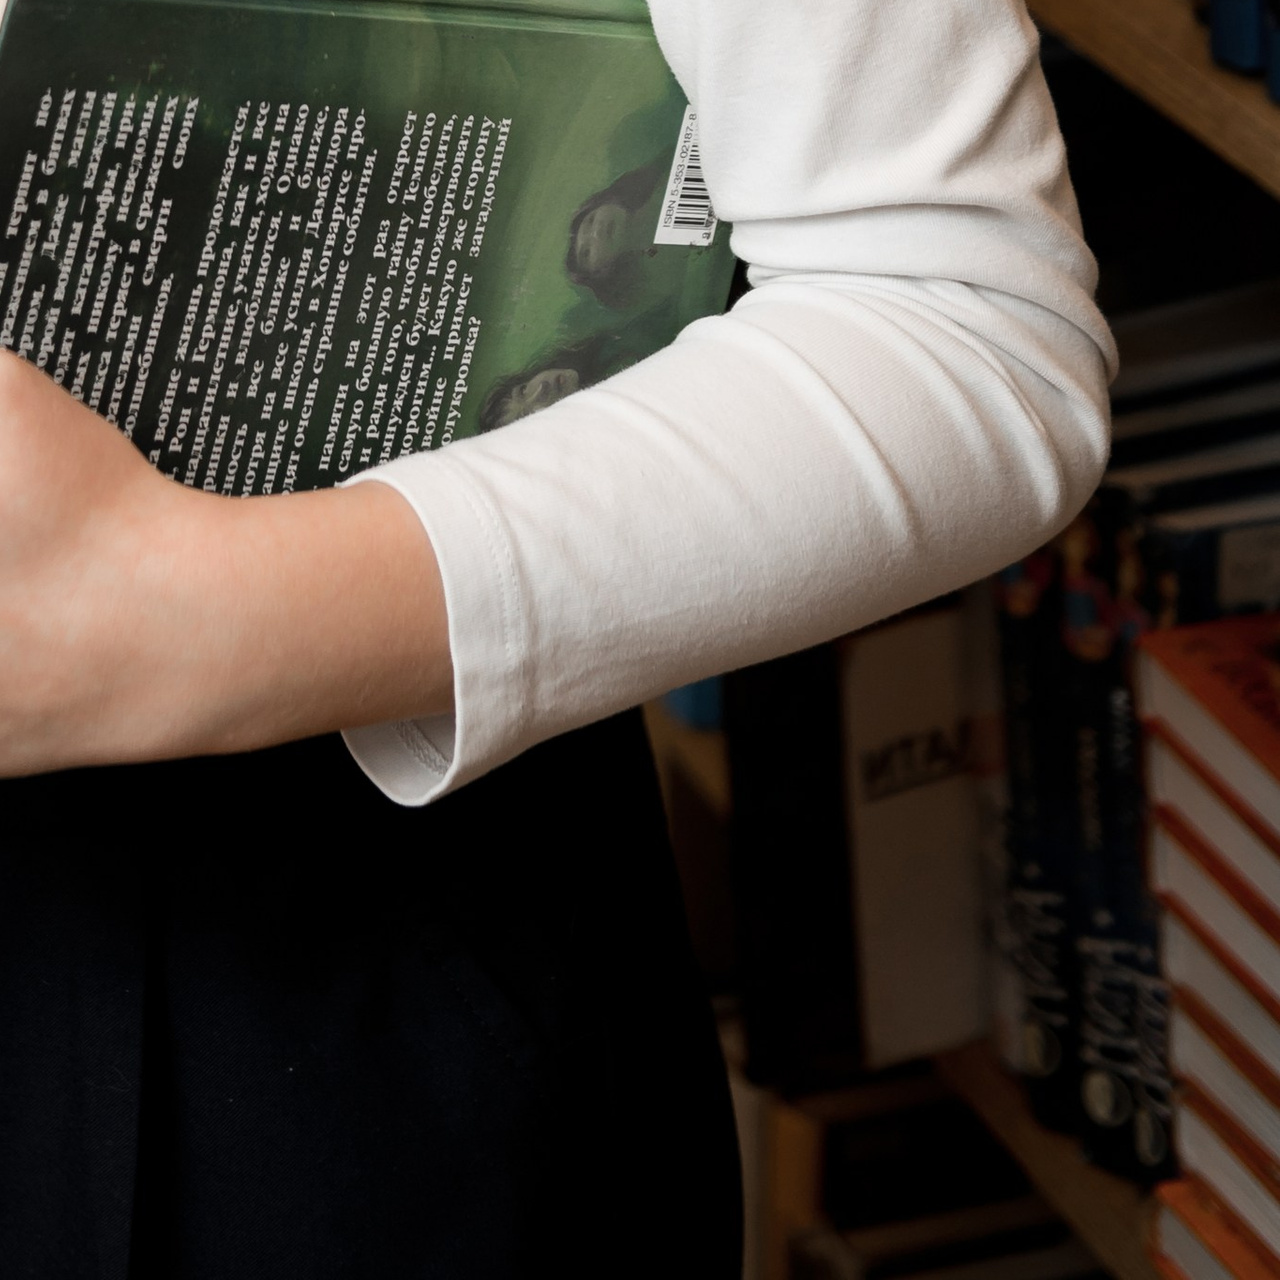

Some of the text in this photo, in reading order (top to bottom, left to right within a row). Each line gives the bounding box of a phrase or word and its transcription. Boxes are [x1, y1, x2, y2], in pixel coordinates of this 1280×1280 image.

[5, 150, 38, 239] терпит
[35, 87, 53, 127] по-
[31, 307, 61, 369] орой
[53, 221, 84, 301] войны
[82, 91, 118, 189] каждый
[36, 189, 49, 205] в
[40, 193, 69, 261] Даже
[67, 90, 97, 168] маглы
[41, 89, 77, 176] битвах
[48, 92, 137, 385] одят катастрофы, при-
[65, 94, 159, 400] рых никому неведомы.
[105, 262, 135, 343] теряет
[128, 238, 141, 254] в
[135, 95, 180, 231] сражениях
[229, 184, 250, 227] как
[244, 154, 257, 171] и
[251, 101, 271, 140] все
[405, 282, 432, 346] будет
[425, 114, 475, 276] пожертвовать
[427, 259, 458, 336] Какую
[451, 218, 468, 251] же
[462, 115, 496, 211] сторону
[662, 113, 698, 228] ISBN 5-353-02187-8
[100, 96, 200, 427] рателями смерти своих
[154, 368, 182, 441] войне
[174, 283, 204, 362] жизнь
[196, 100, 251, 277] продолжается.
[179, 103, 291, 487] надцатилетние, учатся, ходят на
[186, 377, 200, 394] и
[191, 240, 237, 363] Гермиона,
[197, 103, 310, 492] ринки и влюбляются. Однако
[216, 105, 330, 497] сность все ближе и ближе.
[235, 107, 349, 500] мотря на все усилия Дамблдора
[262, 108, 366, 495] ащите школы, в Хогвартсе про-
[294, 377, 319, 448] очень
[312, 259, 350, 375] странные
[343, 149, 378, 256] события.
[318, 383, 350, 470] памяти
[344, 339, 361, 368] на
[356, 273, 377, 324] этот
[372, 219, 391, 259] раз
[386, 110, 418, 204] откроет
[338, 399, 364, 473] самую
[355, 286, 393, 392] большую
[386, 212, 414, 279] тайну
[401, 112, 437, 205] Темного
[359, 114, 459, 463] и ради того, чтобы победить,
[421, 117, 513, 448] войне примет загадочный
[441, 316, 482, 447] олукровка?
[168, 408, 192, 452] Рон
